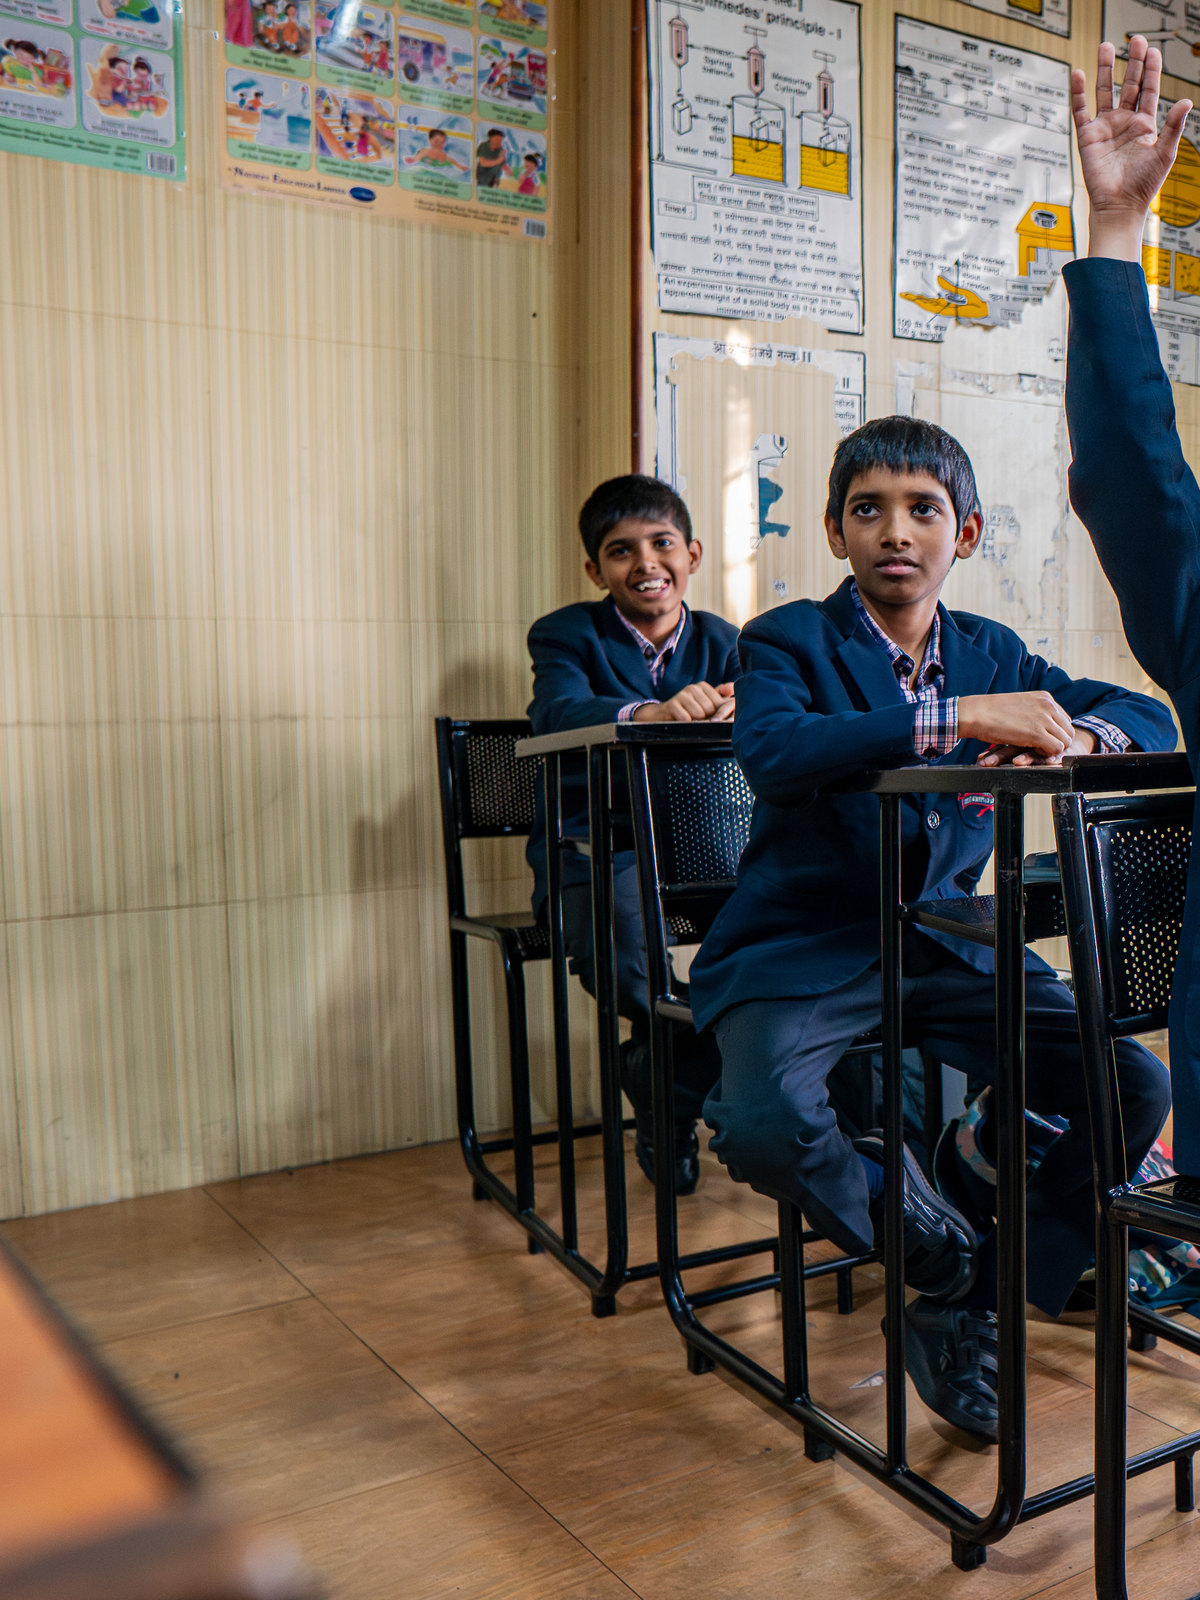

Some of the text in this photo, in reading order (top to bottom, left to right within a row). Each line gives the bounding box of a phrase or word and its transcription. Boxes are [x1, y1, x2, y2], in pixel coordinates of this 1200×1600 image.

[766, 11, 826, 37] principle
[703, 55, 732, 70] Spring
[988, 49, 1023, 67] Force
[702, 66, 735, 79] balance
[771, 72, 813, 90] Measuring
[664, 277, 675, 287] An
[677, 279, 723, 293] experiment
[725, 283, 733, 293] to
[735, 284, 775, 298] determine
[777, 289, 789, 300] the
[791, 291, 819, 306] change
[821, 296, 828, 305] in
[830, 297, 842, 307] the
[664, 288, 701, 303] apparent
[703, 291, 730, 304] weight
[732, 295, 740, 304] of
[749, 297, 769, 308] solid
[770, 299, 790, 312] body
[792, 303, 801, 311] as
[819, 305, 855, 319] gradually
[716, 306, 756, 318] immersed
[757, 308, 765, 318] in
